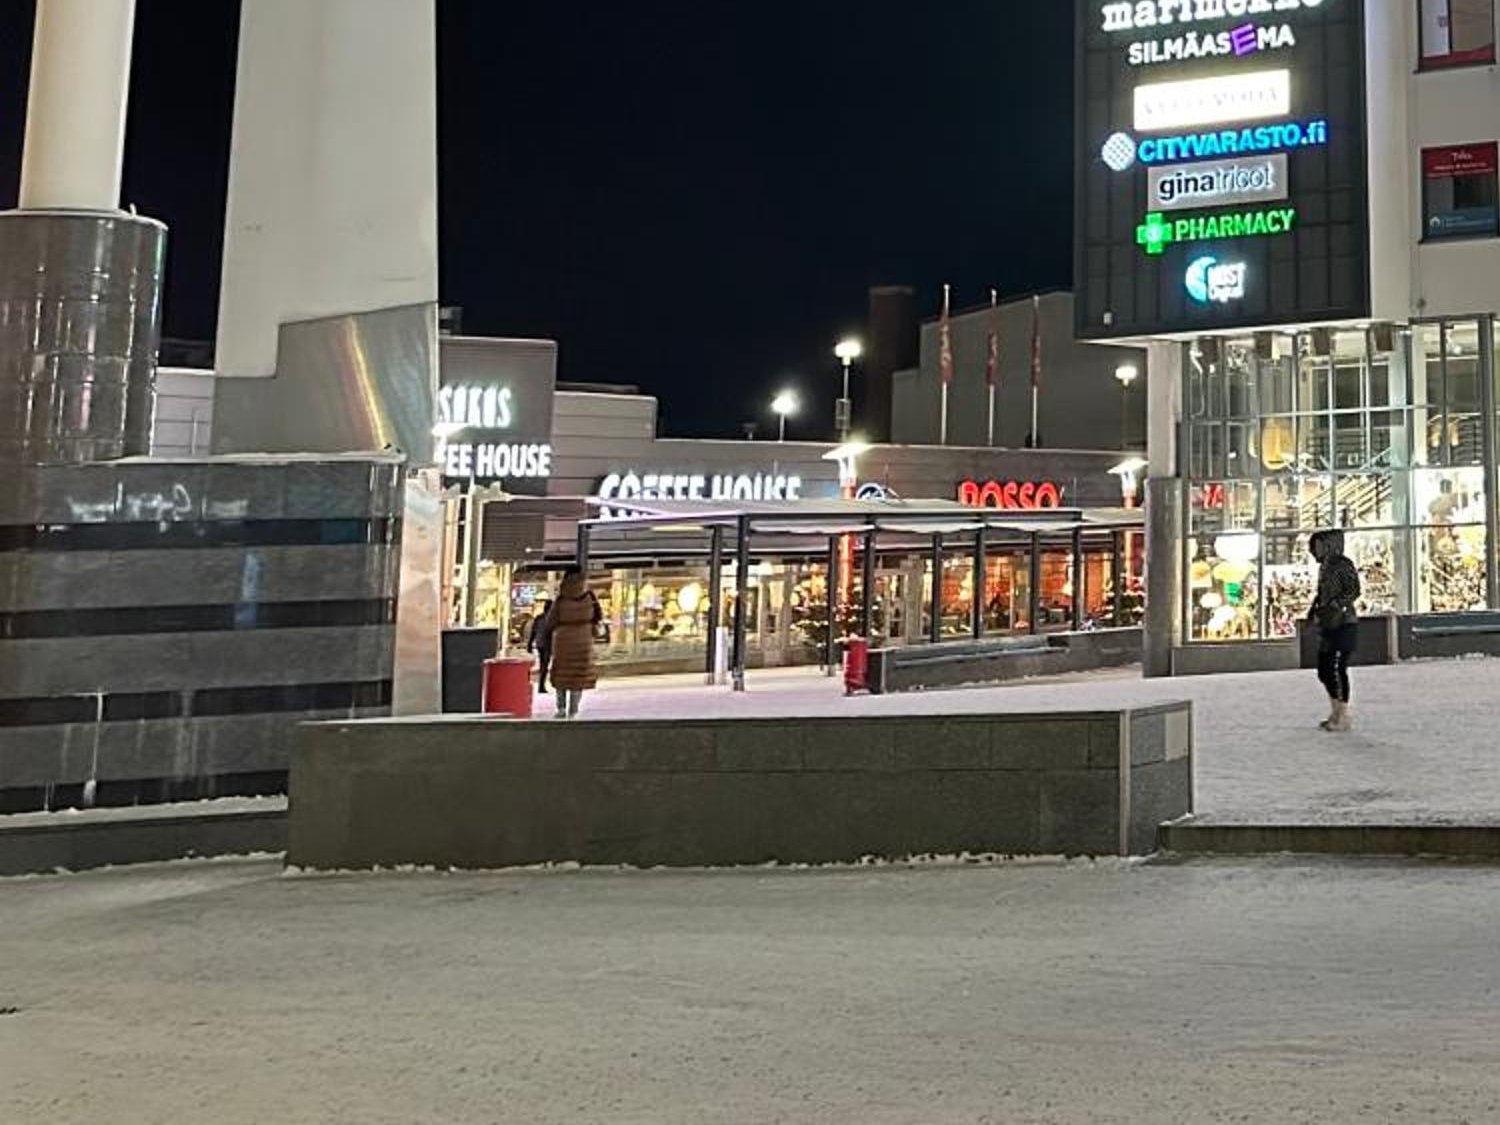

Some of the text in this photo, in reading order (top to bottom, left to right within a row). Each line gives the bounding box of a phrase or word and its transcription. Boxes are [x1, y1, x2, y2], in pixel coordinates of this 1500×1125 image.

[1128, 23, 1295, 65] SILMÄASEMA
[1175, 209, 1295, 242] PHARMACY
[477, 442, 552, 477] HOUSE
